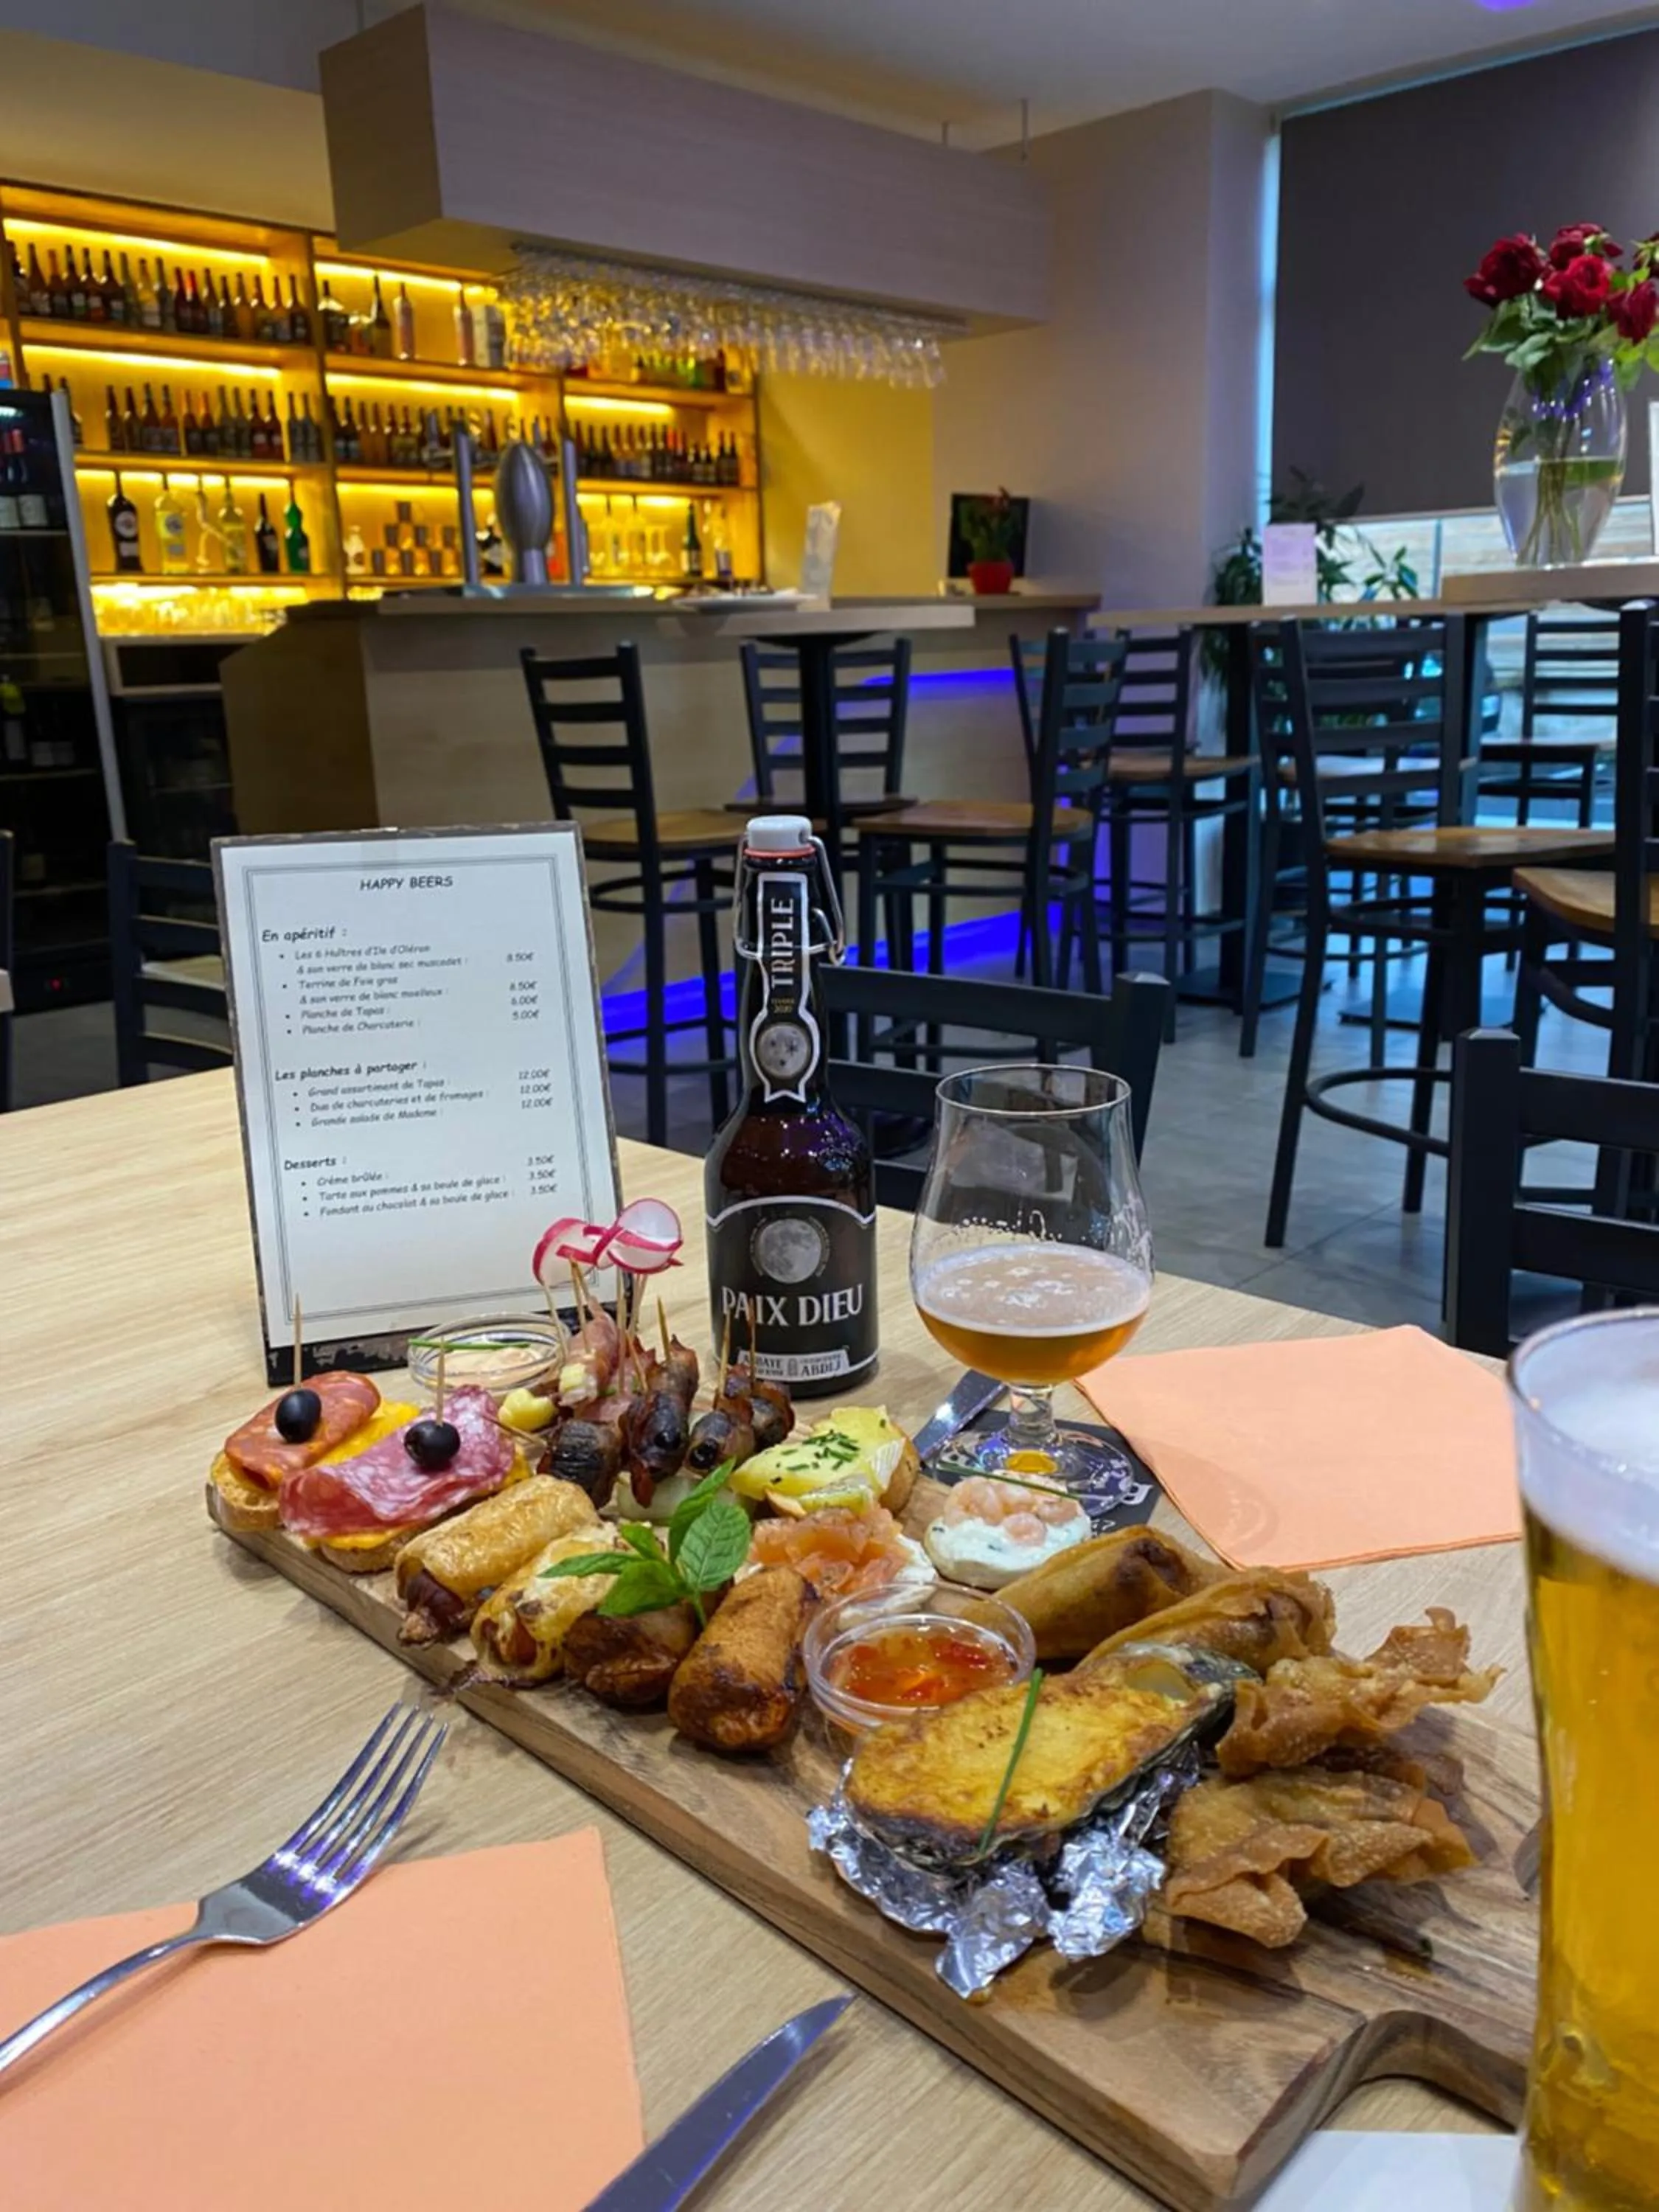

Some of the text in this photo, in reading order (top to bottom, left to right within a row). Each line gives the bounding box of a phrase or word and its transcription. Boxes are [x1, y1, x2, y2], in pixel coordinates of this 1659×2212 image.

[361, 875, 453, 891] HAPPY BEERS
[262, 929, 279, 942] En
[284, 925, 335, 943] apéritif
[771, 897, 795, 989] TRIPLE
[295, 950, 312, 960] Les
[316, 950, 321, 958] 6
[296, 965, 304, 975] &
[327, 964, 353, 973] verre
[355, 962, 367, 971] de
[370, 961, 394, 970] blanc
[399, 961, 414, 969] sec
[417, 957, 462, 967] muscadet
[299, 977, 398, 990] Terrine de Foie gras
[299, 995, 307, 1004] &
[330, 994, 356, 1002] verre
[358, 992, 370, 1001] de
[374, 991, 399, 1000] blanc
[401, 988, 442, 998] moelleux
[301, 1009, 337, 1019] Planche
[341, 1009, 352, 1017] de
[356, 1006, 385, 1017] Tapas
[302, 1024, 340, 1034] Planche
[342, 1023, 354, 1032] de
[357, 1020, 414, 1031] Charcuterie
[275, 1070, 295, 1081] Les
[300, 1066, 350, 1081] planches
[354, 1063, 362, 1074] à
[366, 1062, 418, 1076] partager
[308, 1086, 339, 1098] Grand
[341, 1082, 399, 1095] assortiment
[401, 1081, 414, 1090] de
[417, 1079, 445, 1090] Tapas
[310, 1102, 330, 1113] Duo
[332, 1101, 344, 1110] de
[347, 1096, 408, 1109] charcuteries
[411, 1095, 421, 1103] et
[425, 1093, 437, 1102] de
[439, 1090, 484, 1101] fromages
[311, 1116, 347, 1127] Grande
[349, 1113, 380, 1124] salade
[383, 1112, 394, 1121] de
[397, 1109, 437, 1119] Madame
[285, 1157, 337, 1171] Desserts
[351, 1171, 383, 1183] brûlée
[319, 1191, 347, 1201] Tarte
[370, 1186, 408, 1197] pommes
[411, 1183, 418, 1192] &
[434, 1179, 459, 1190] boule
[462, 1178, 473, 1187] de
[476, 1176, 501, 1188] glace
[319, 1205, 359, 1217] Fondant
[362, 1204, 375, 1212] au
[376, 1199, 417, 1211] chocolat
[420, 1197, 427, 1206] &
[429, 1197, 440, 1206] sa
[442, 1192, 468, 1204] boule
[470, 1192, 482, 1201] de
[484, 1190, 509, 1203] glace
[722, 1284, 863, 1326] PAIX DIEU
